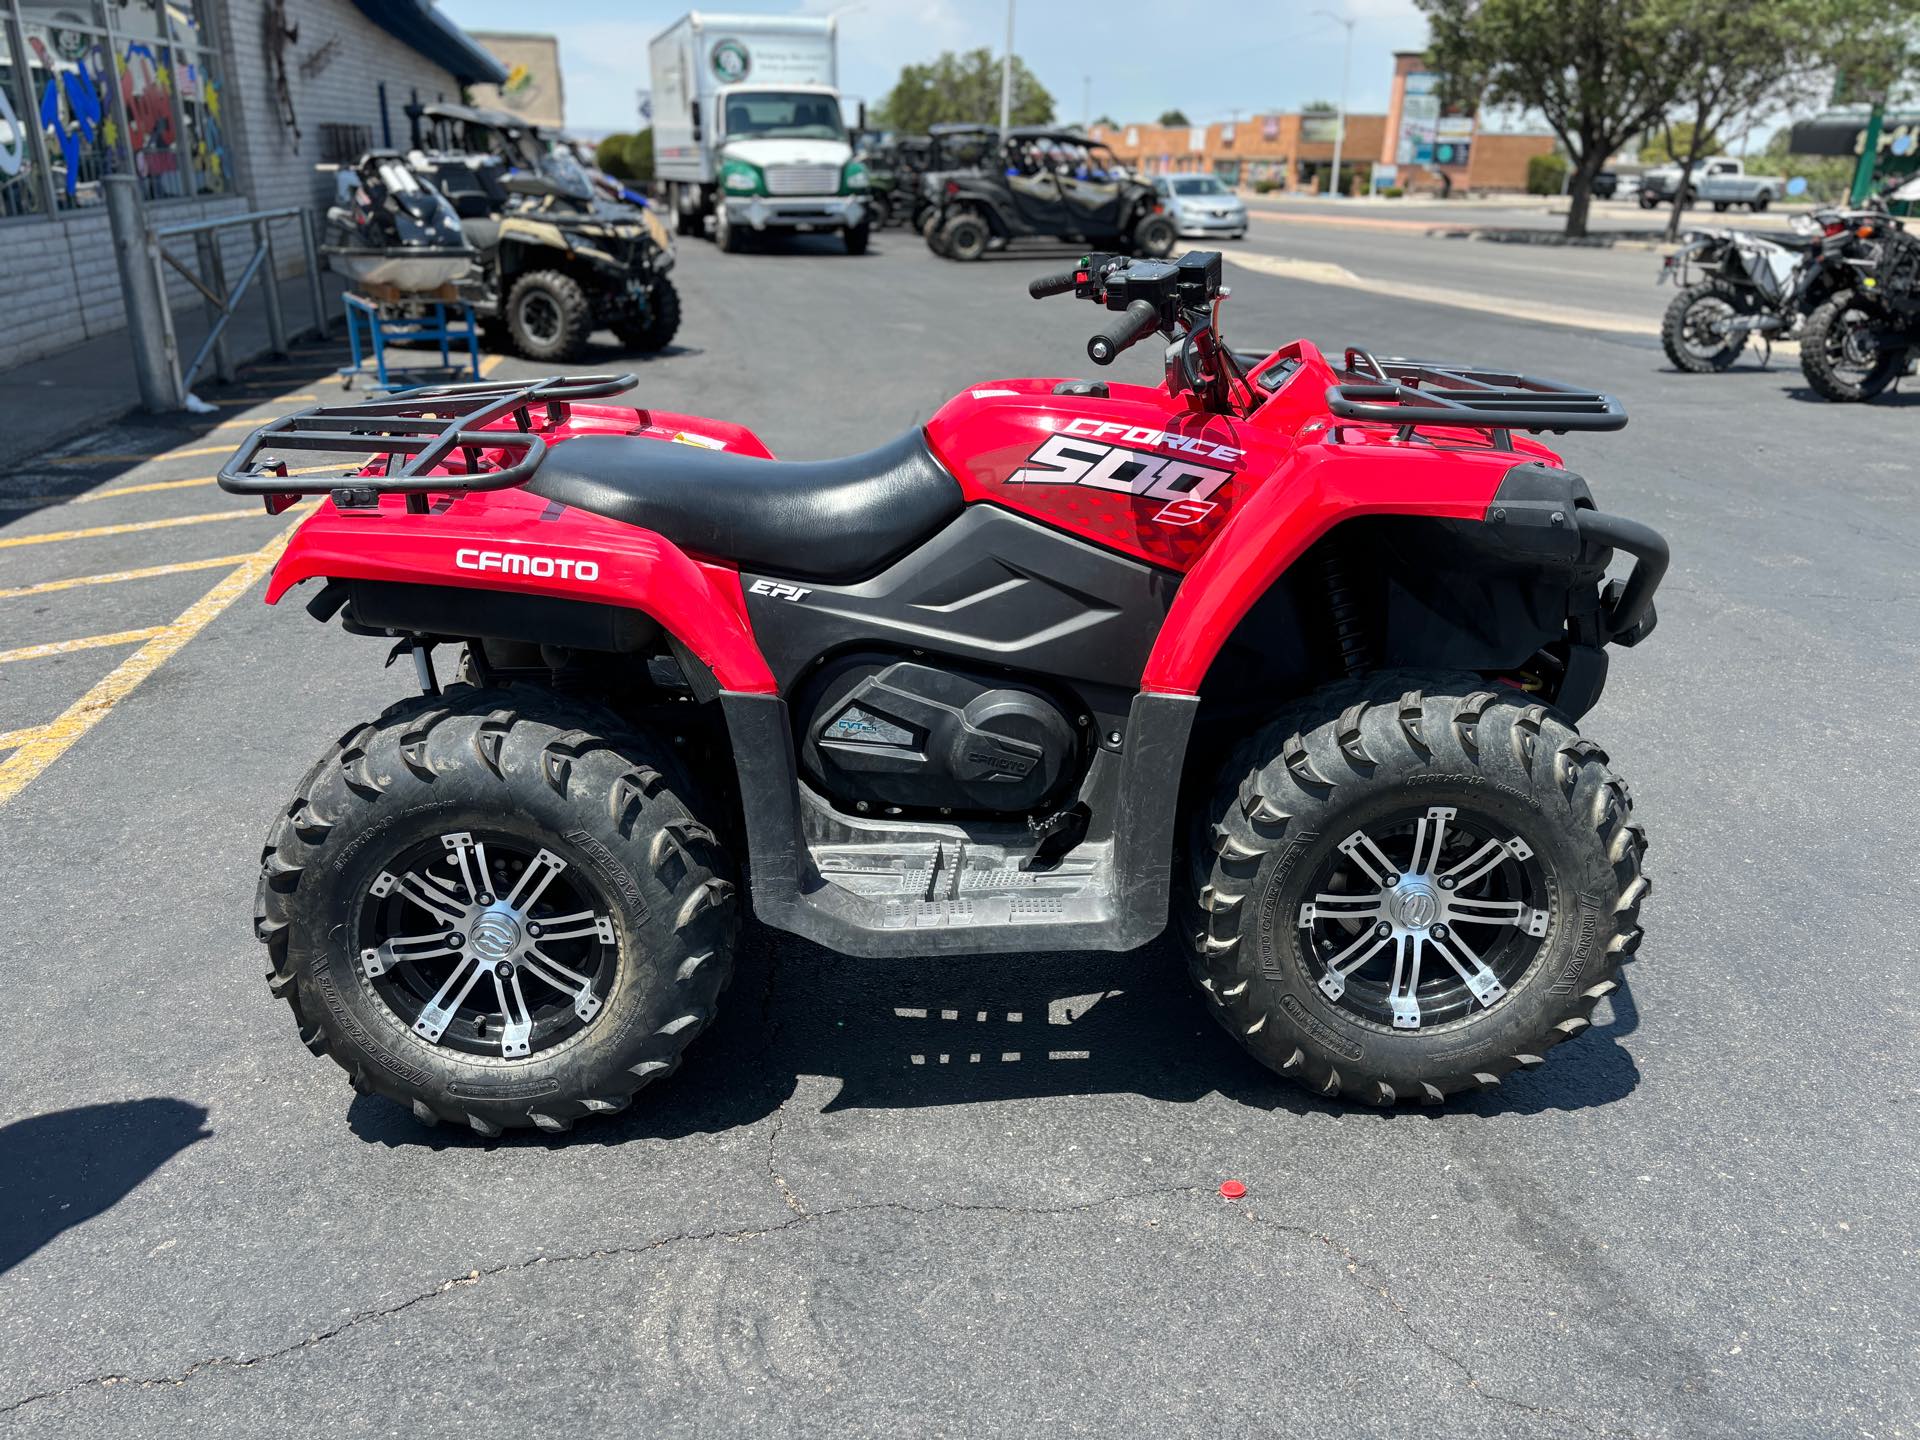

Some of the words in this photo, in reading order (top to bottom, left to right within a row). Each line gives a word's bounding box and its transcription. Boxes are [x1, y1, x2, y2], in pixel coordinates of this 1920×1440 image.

[1063, 418, 1246, 462] CFORCE
[1004, 433, 1237, 501] 500
[1152, 498, 1218, 526] S
[456, 548, 599, 581] CFMOTO
[748, 579, 813, 602] EPS
[968, 752, 1028, 773] CFMOTO
[588, 843, 641, 908] INNOVA
[1262, 886, 1279, 932] GEAR
[1262, 936, 1274, 967] MUD
[1564, 914, 1596, 979] INNOVA
[340, 1017, 378, 1055] GEAR
[378, 1053, 413, 1077] MUD
